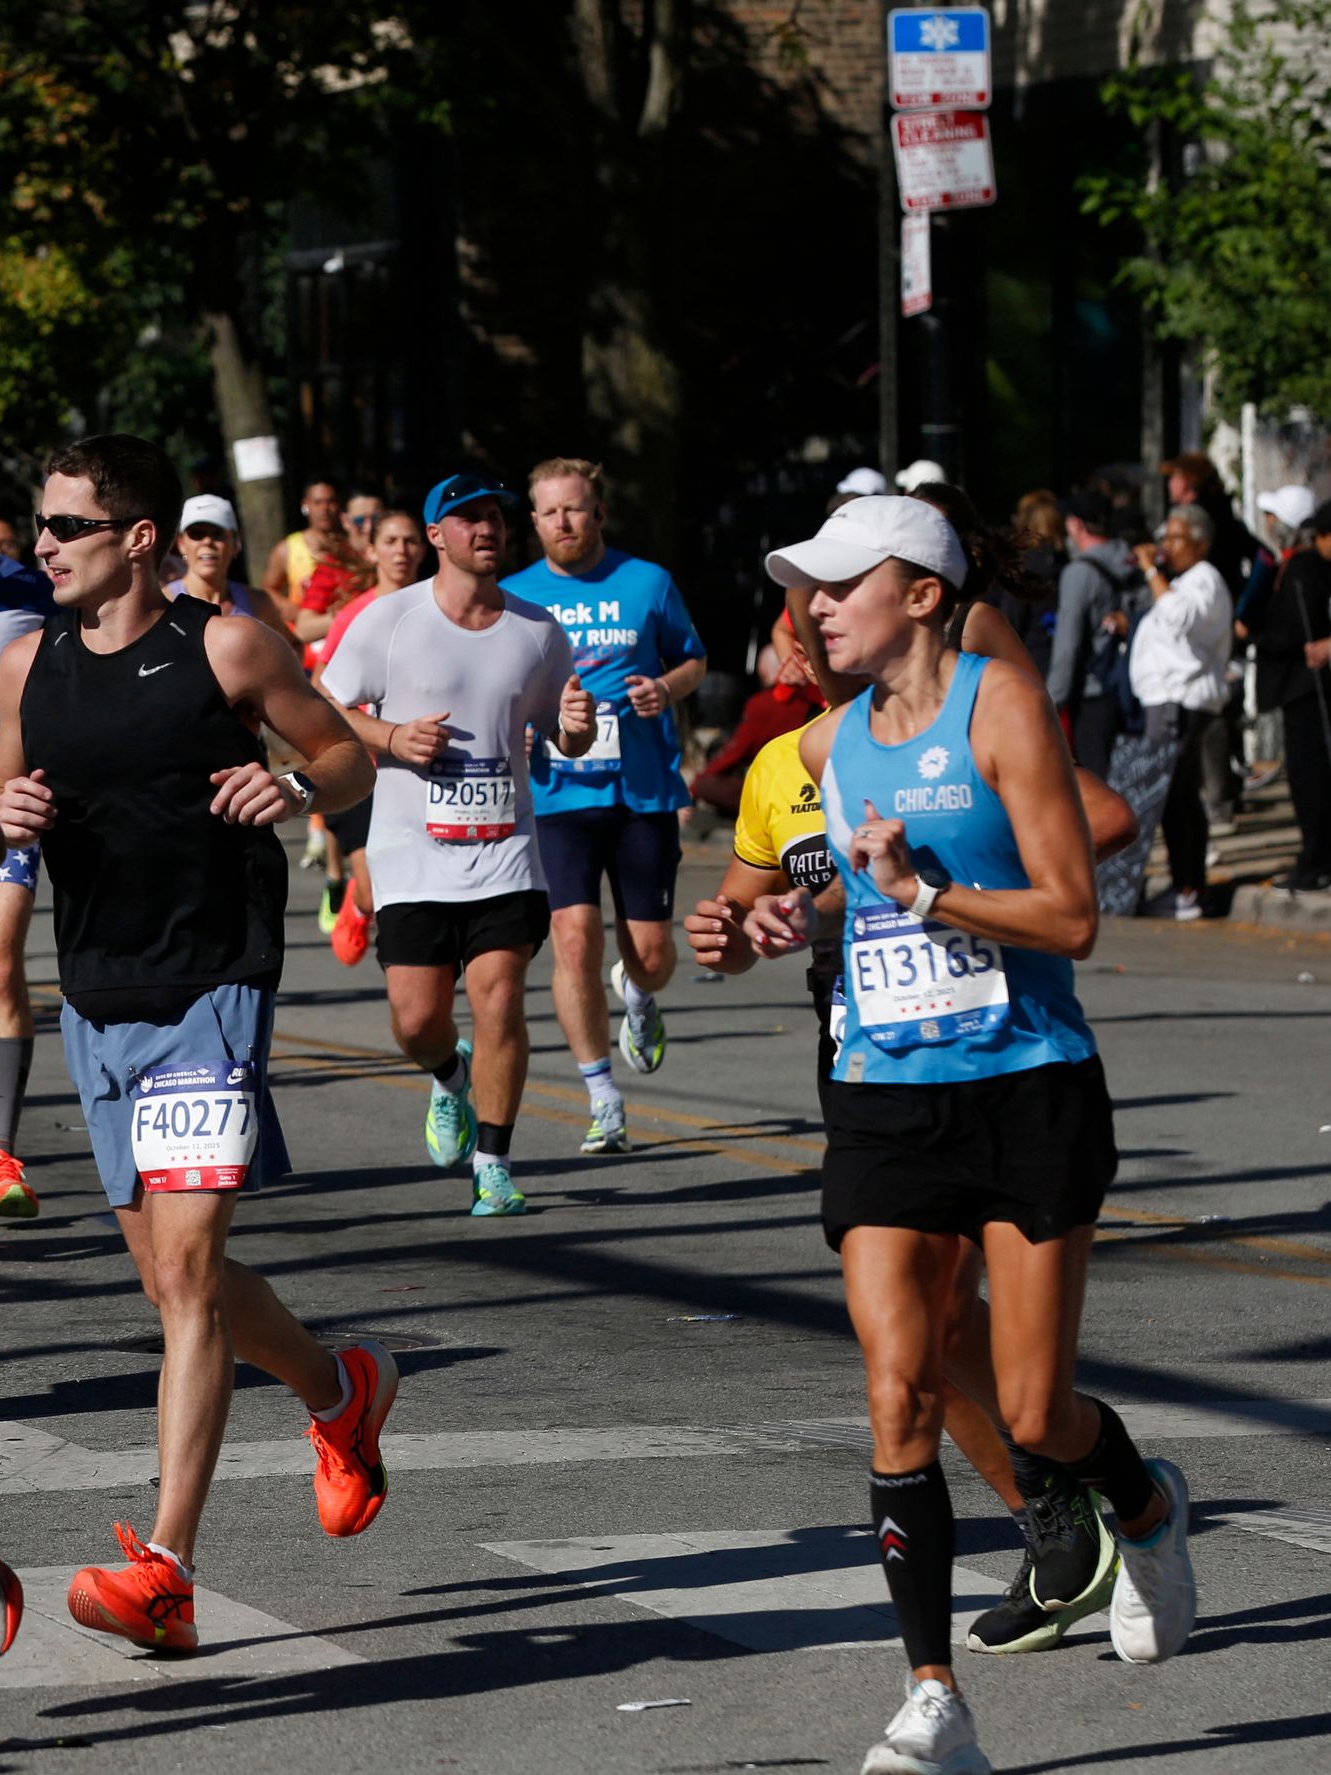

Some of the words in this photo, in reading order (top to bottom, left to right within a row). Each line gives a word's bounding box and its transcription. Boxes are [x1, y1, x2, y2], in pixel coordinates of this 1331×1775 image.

[598, 600, 620, 623] M
[587, 629, 638, 647] RUNS
[429, 781, 511, 806] D20517
[894, 784, 973, 813] CHICAGO
[856, 936, 995, 992] E13165
[153, 1078, 177, 1089] CHICAGO
[177, 1076, 216, 1087] MARATHON
[173, 1070, 198, 1078] AMERICA
[136, 1098, 250, 1142] F40277
[166, 1144, 190, 1152] October
[204, 1142, 221, 1150] 2025
